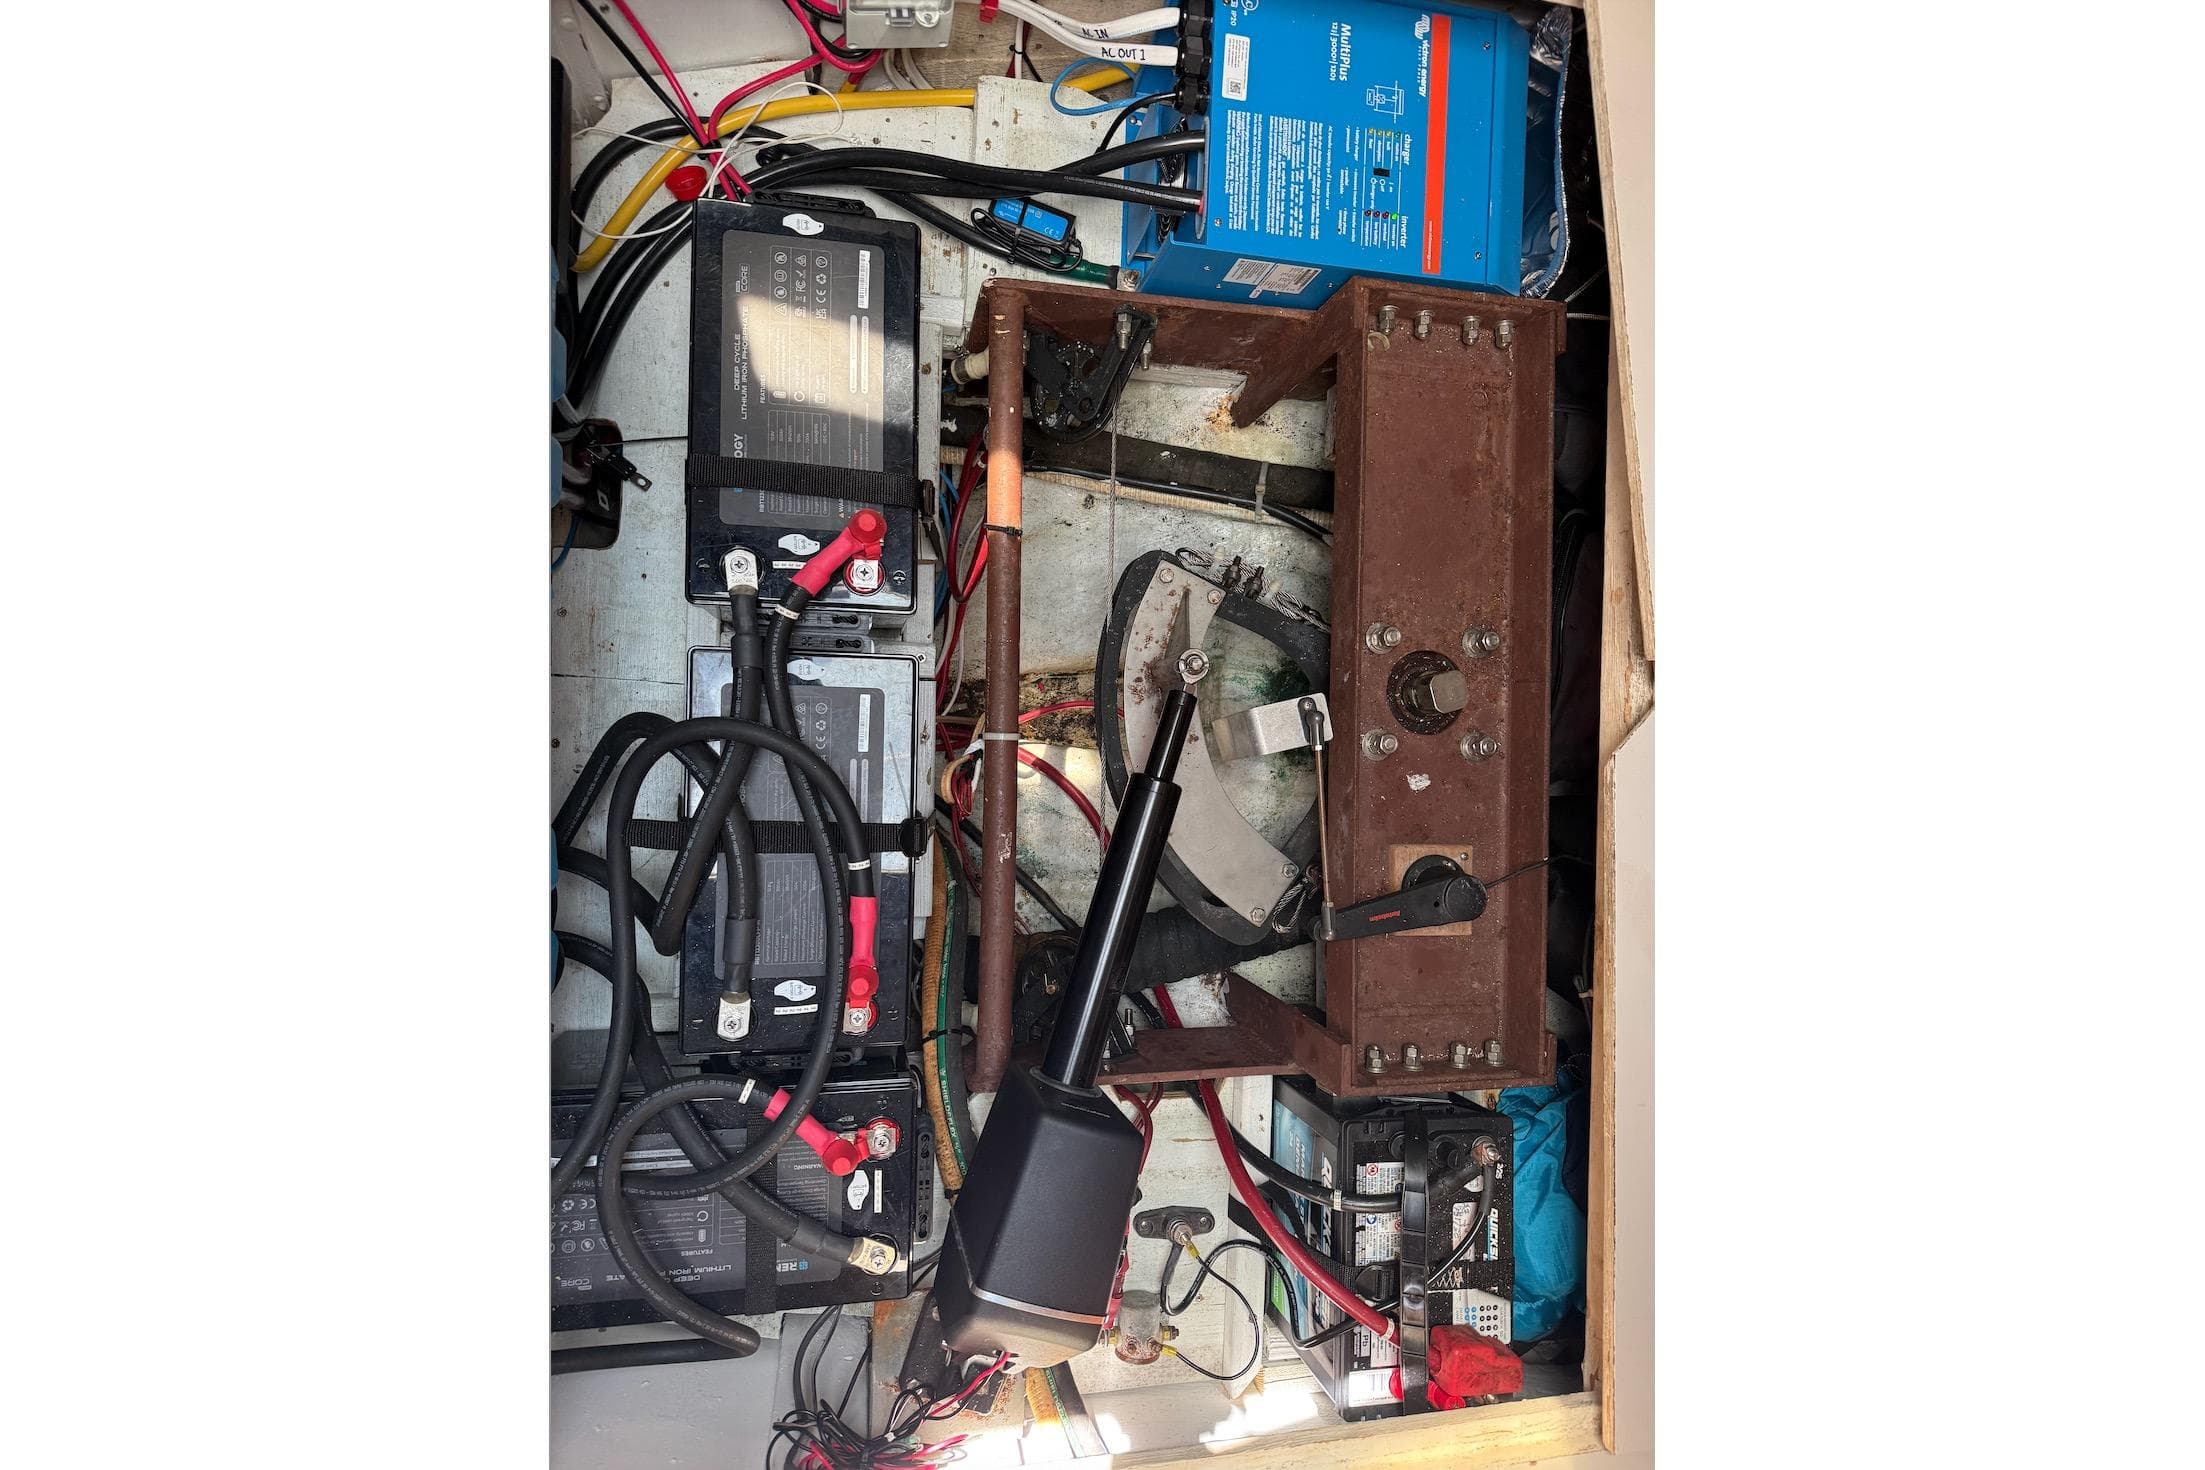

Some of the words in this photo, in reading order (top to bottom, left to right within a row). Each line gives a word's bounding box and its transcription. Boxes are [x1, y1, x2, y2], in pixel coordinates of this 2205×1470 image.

[1095, 28, 1109, 39] IN
[1102, 47, 1116, 58] AC
[1118, 48, 1137, 59] OUT
[1339, 23, 1351, 81] MultiPlus
[1420, 40, 1430, 67] victron
[1418, 68, 1428, 97] energy
[1402, 134, 1412, 166] charger
[1400, 215, 1409, 249] inverter
[741, 265, 749, 291] CORE
[741, 304, 749, 360] PHOSPHATE
[733, 366, 741, 391] DEEP
[1488, 1207, 1500, 1261] QUICKSI
[681, 1248, 713, 1257] FEATURES
[669, 1268, 692, 1276] IRON
[673, 1274, 701, 1283] DEEP
[694, 1264, 732, 1274] LITHIUM
[560, 1278, 591, 1288] CORE
[1362, 1334, 1370, 1347] Pb
